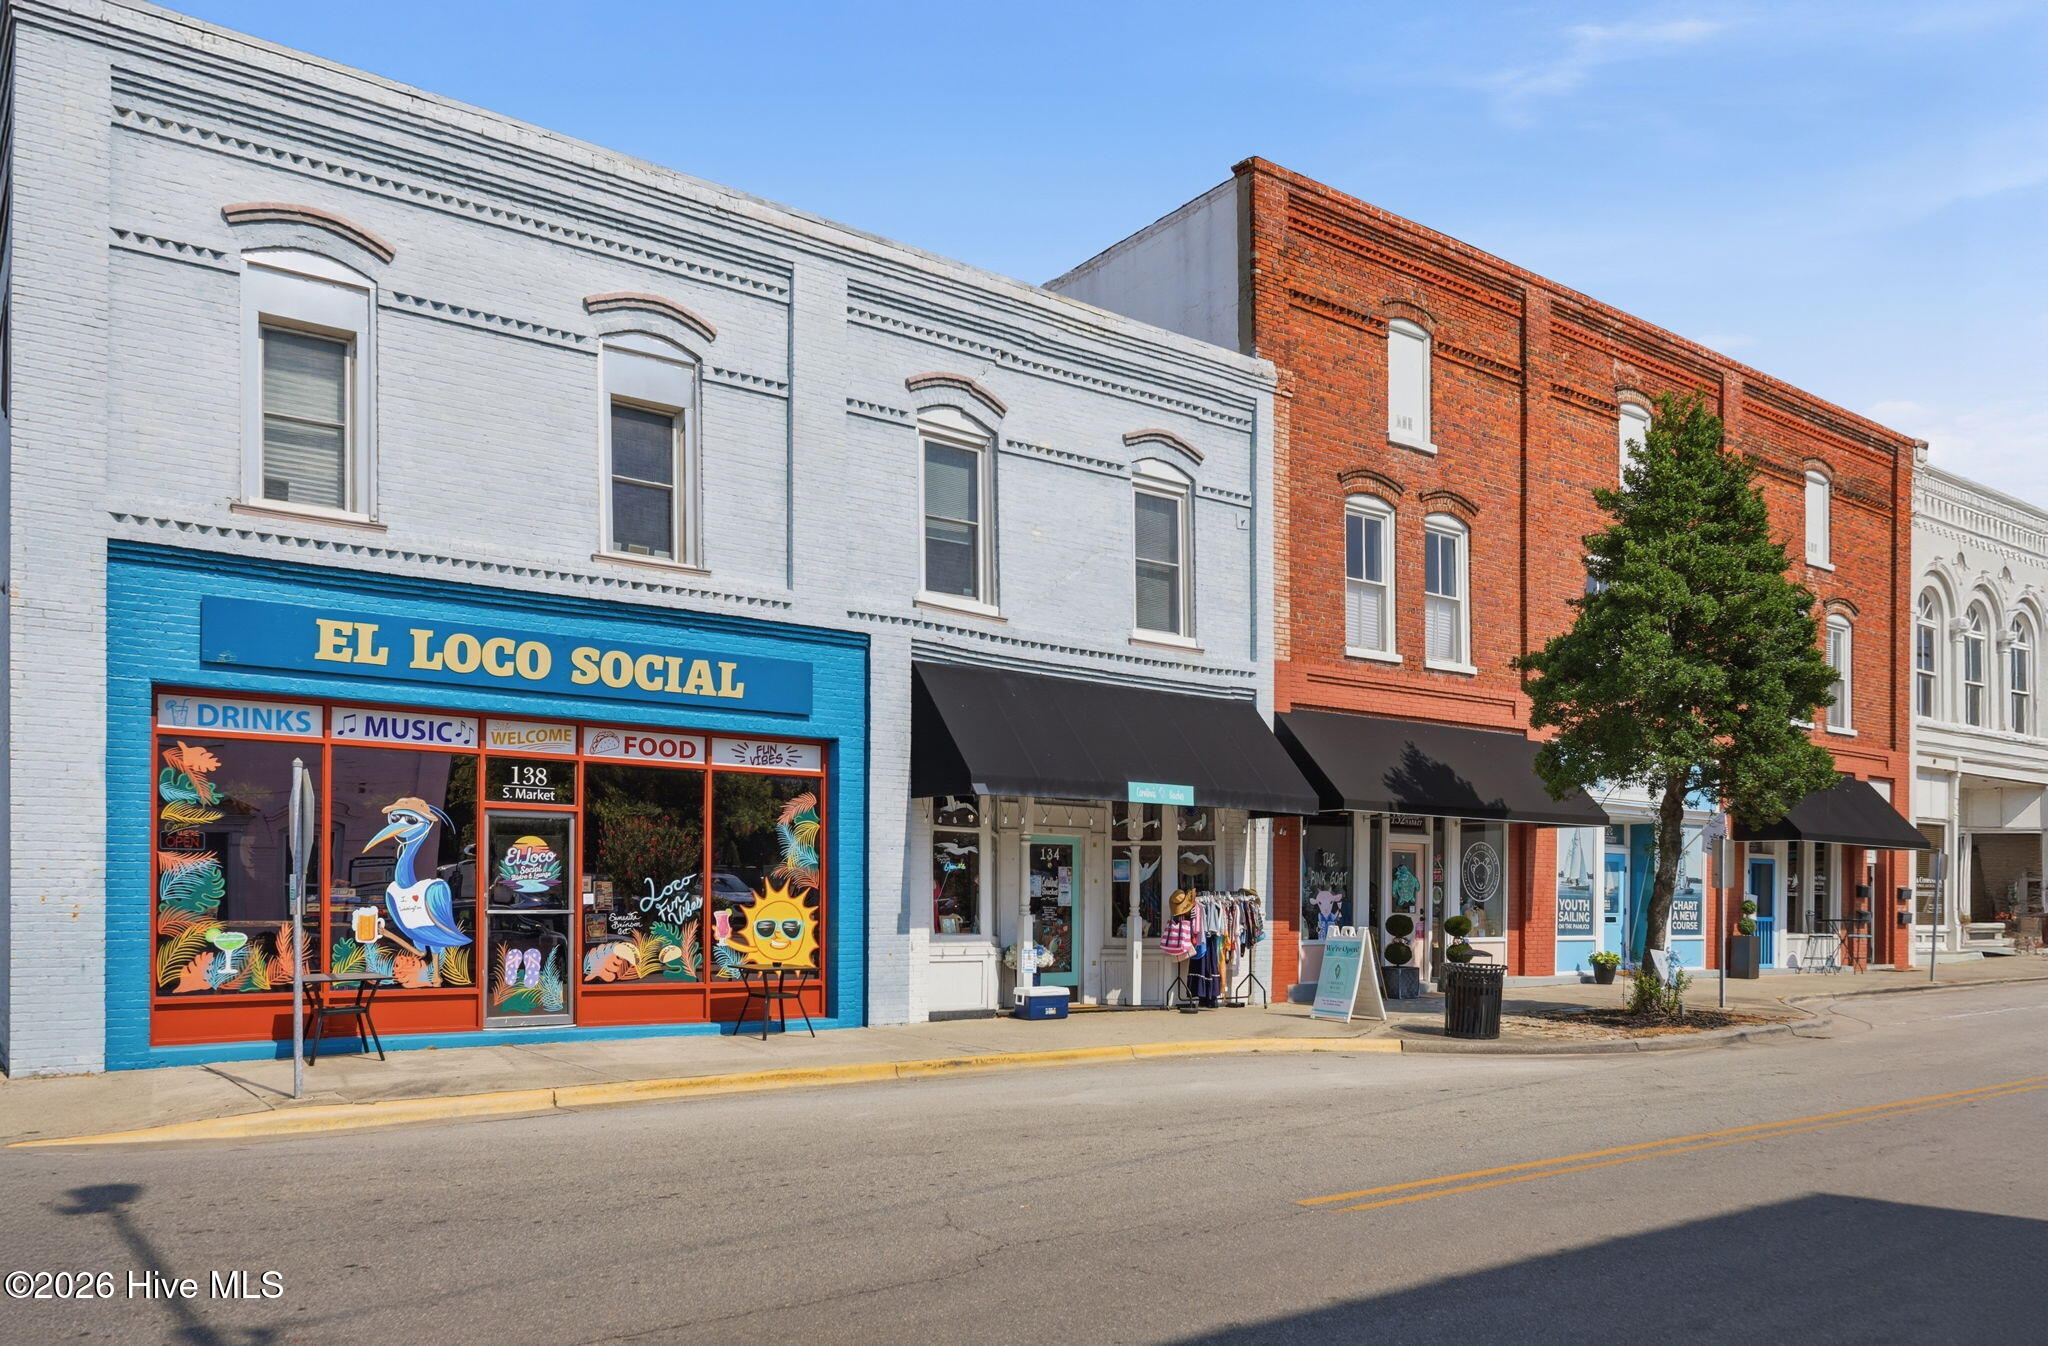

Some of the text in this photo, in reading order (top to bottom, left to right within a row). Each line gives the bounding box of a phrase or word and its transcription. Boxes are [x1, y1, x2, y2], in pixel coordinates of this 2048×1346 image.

[314, 618, 745, 699] EL LOCO SOCIAL
[197, 704, 312, 733] DRINKS
[364, 716, 453, 743] MUSIC
[490, 728, 572, 745] WELCOME
[624, 736, 697, 759] FOOD
[756, 744, 777, 755] FUN
[750, 753, 783, 766] VIBES
[511, 766, 547, 786] 138
[502, 787, 556, 801] S. Market
[165, 836, 200, 848] OPEN
[505, 846, 557, 867] El Loco
[1040, 848, 1060, 861] 134
[640, 874, 697, 912] Loco
[1559, 898, 1590, 911] YOUTH
[1672, 900, 1699, 911] CHART
[1558, 910, 1591, 923] SAILING
[1672, 910, 1698, 921] A NEW
[1672, 920, 1699, 931] COURSE
